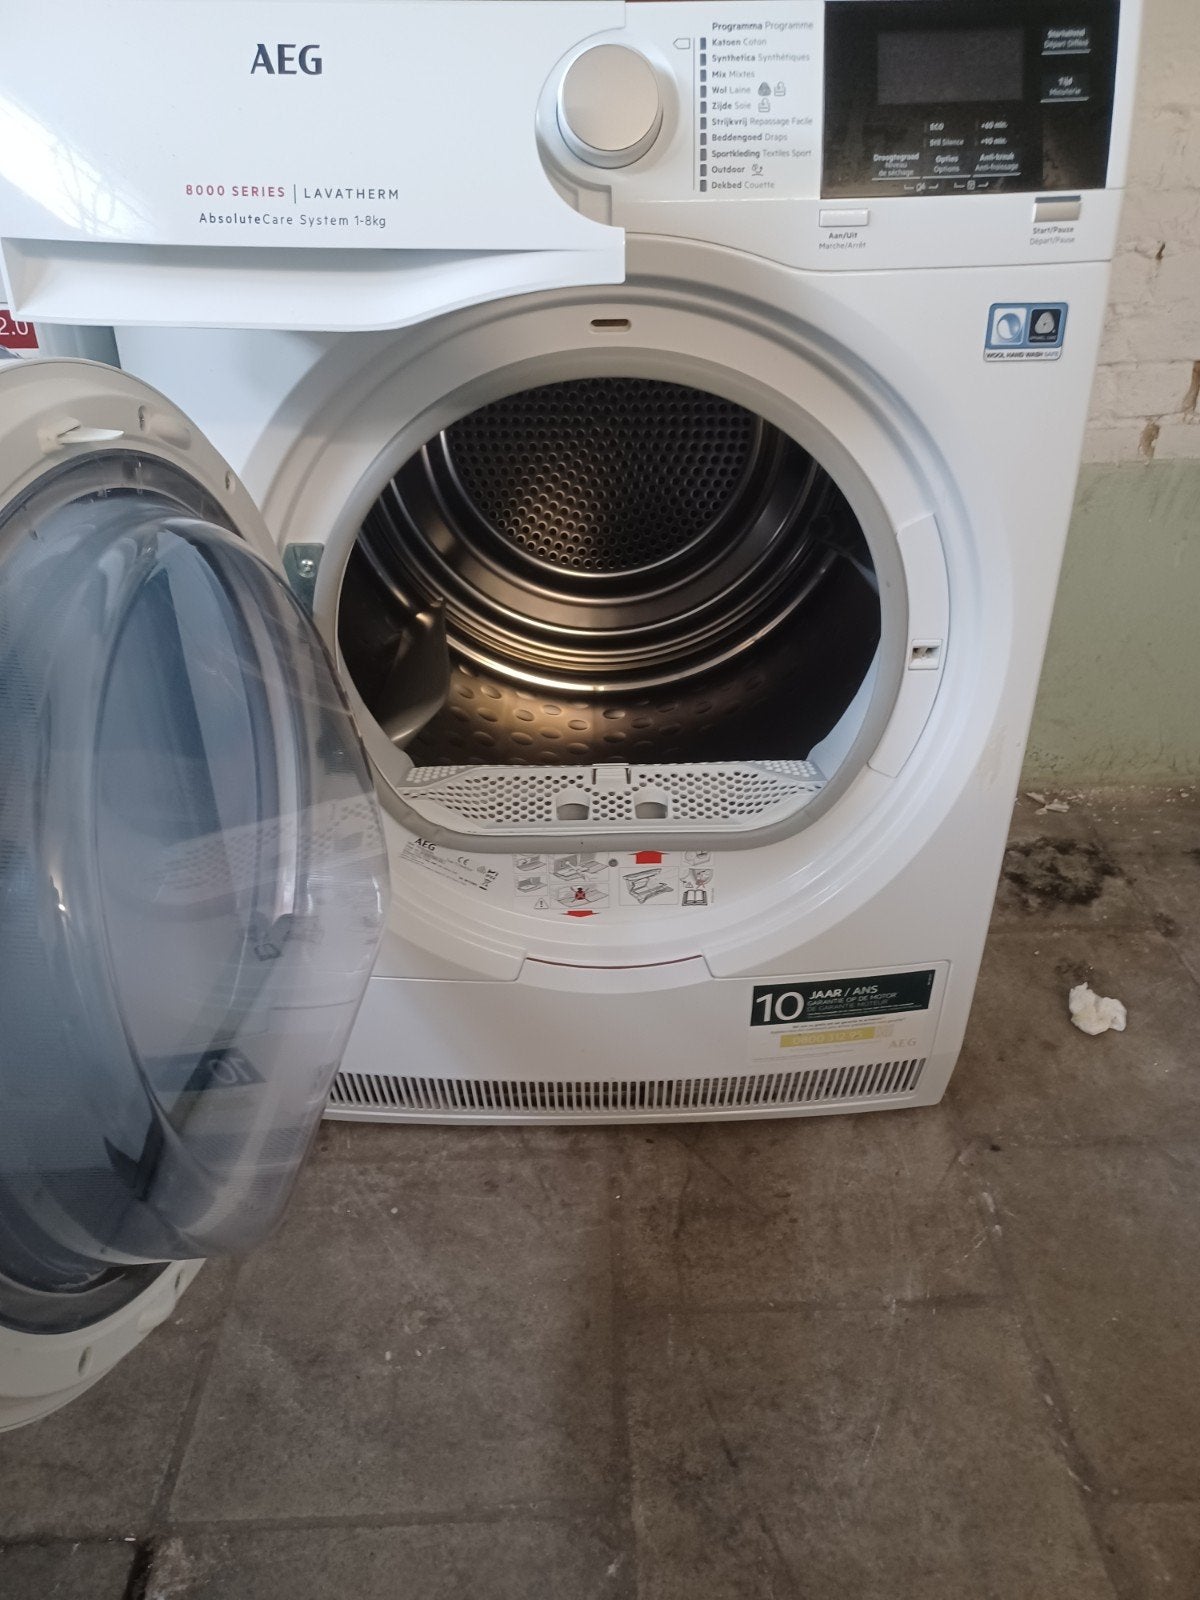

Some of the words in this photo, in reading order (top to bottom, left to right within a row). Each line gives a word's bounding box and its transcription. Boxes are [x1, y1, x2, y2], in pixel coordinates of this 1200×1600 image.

[712, 22, 763, 32] Programma
[764, 21, 814, 32] Programme
[712, 38, 741, 46] Katoen
[742, 38, 767, 46] Coton
[250, 43, 323, 75] AEG
[712, 53, 756, 63] Synthetica
[712, 70, 727, 78] Mix
[728, 70, 755, 78] Mixtes
[712, 86, 727, 94] Wol
[729, 86, 751, 94] Laine
[712, 102, 732, 111] Zijde
[734, 102, 752, 110] Soie
[712, 117, 748, 127] Strijkvrij
[749, 117, 790, 126] Repassage
[791, 117, 813, 126] Facile
[712, 133, 763, 142] Beddengoed
[764, 133, 788, 142] Draps
[712, 149, 760, 159] Sportkleding
[762, 148, 790, 158] Textiles
[791, 148, 812, 158] Sport
[711, 165, 745, 174] Outdoor
[711, 181, 742, 190] Dekbed
[744, 181, 775, 190] Couette
[185, 184, 225, 196] 8000
[232, 186, 285, 198] SERIES
[303, 188, 400, 201] LAVATHERM
[199, 212, 293, 225] AbsoluteCare
[299, 214, 349, 228] System
[355, 215, 386, 229] 1-8kg
[1032, 226, 1075, 235] Start/Pause
[828, 232, 858, 240] Aan/Uit
[414, 837, 437, 852] AEG
[809, 989, 843, 1000] JAAR
[852, 985, 879, 995] ANS
[807, 998, 845, 1006] GARANTIE
[869, 992, 898, 1000] MOTOR
[756, 991, 805, 1022] 10
[888, 1038, 917, 1049] AEG
